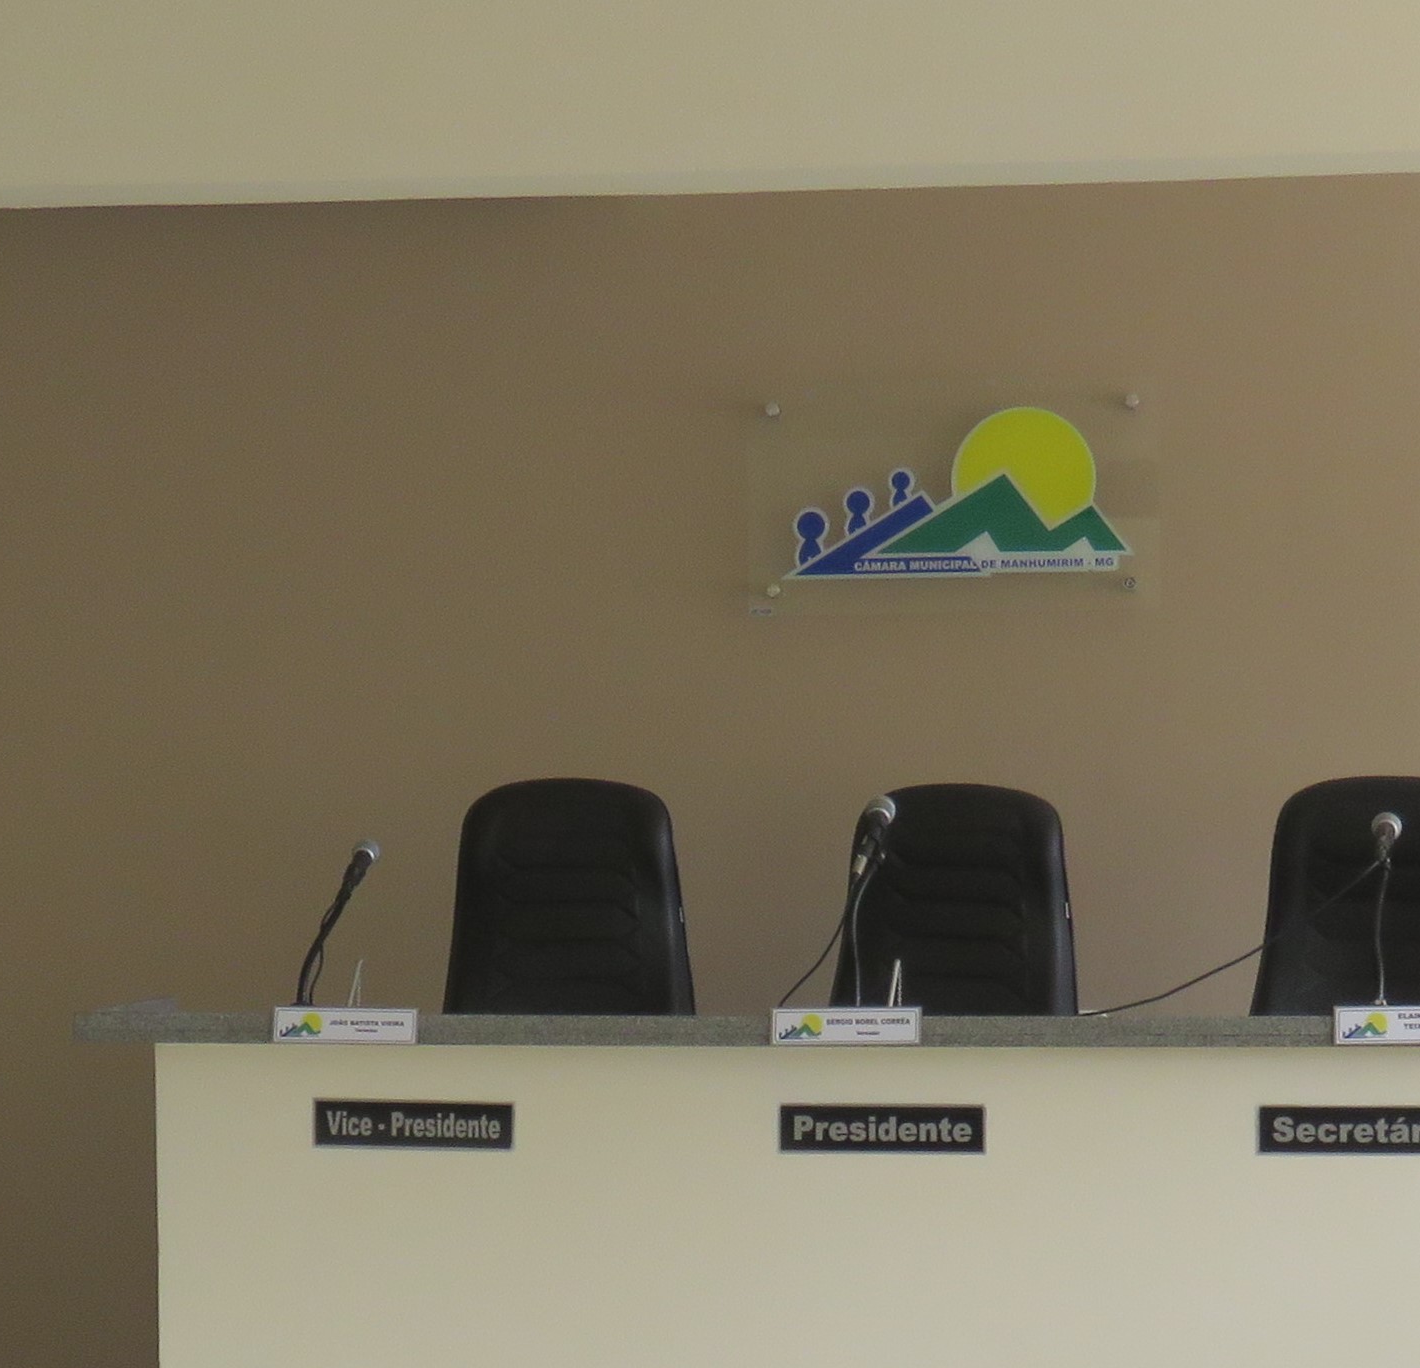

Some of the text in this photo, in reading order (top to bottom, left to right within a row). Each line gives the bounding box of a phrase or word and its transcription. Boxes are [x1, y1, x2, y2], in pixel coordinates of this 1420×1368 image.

[854, 558, 906, 572] CÂMARA
[910, 558, 978, 571] MUNICIPAL
[981, 558, 996, 569] DE
[1000, 557, 1085, 569] MANHUMIRIM
[1095, 556, 1115, 568] MG
[326, 1110, 372, 1135] Vice
[391, 1111, 500, 1139] Presidente
[793, 1115, 972, 1142] Presidente
